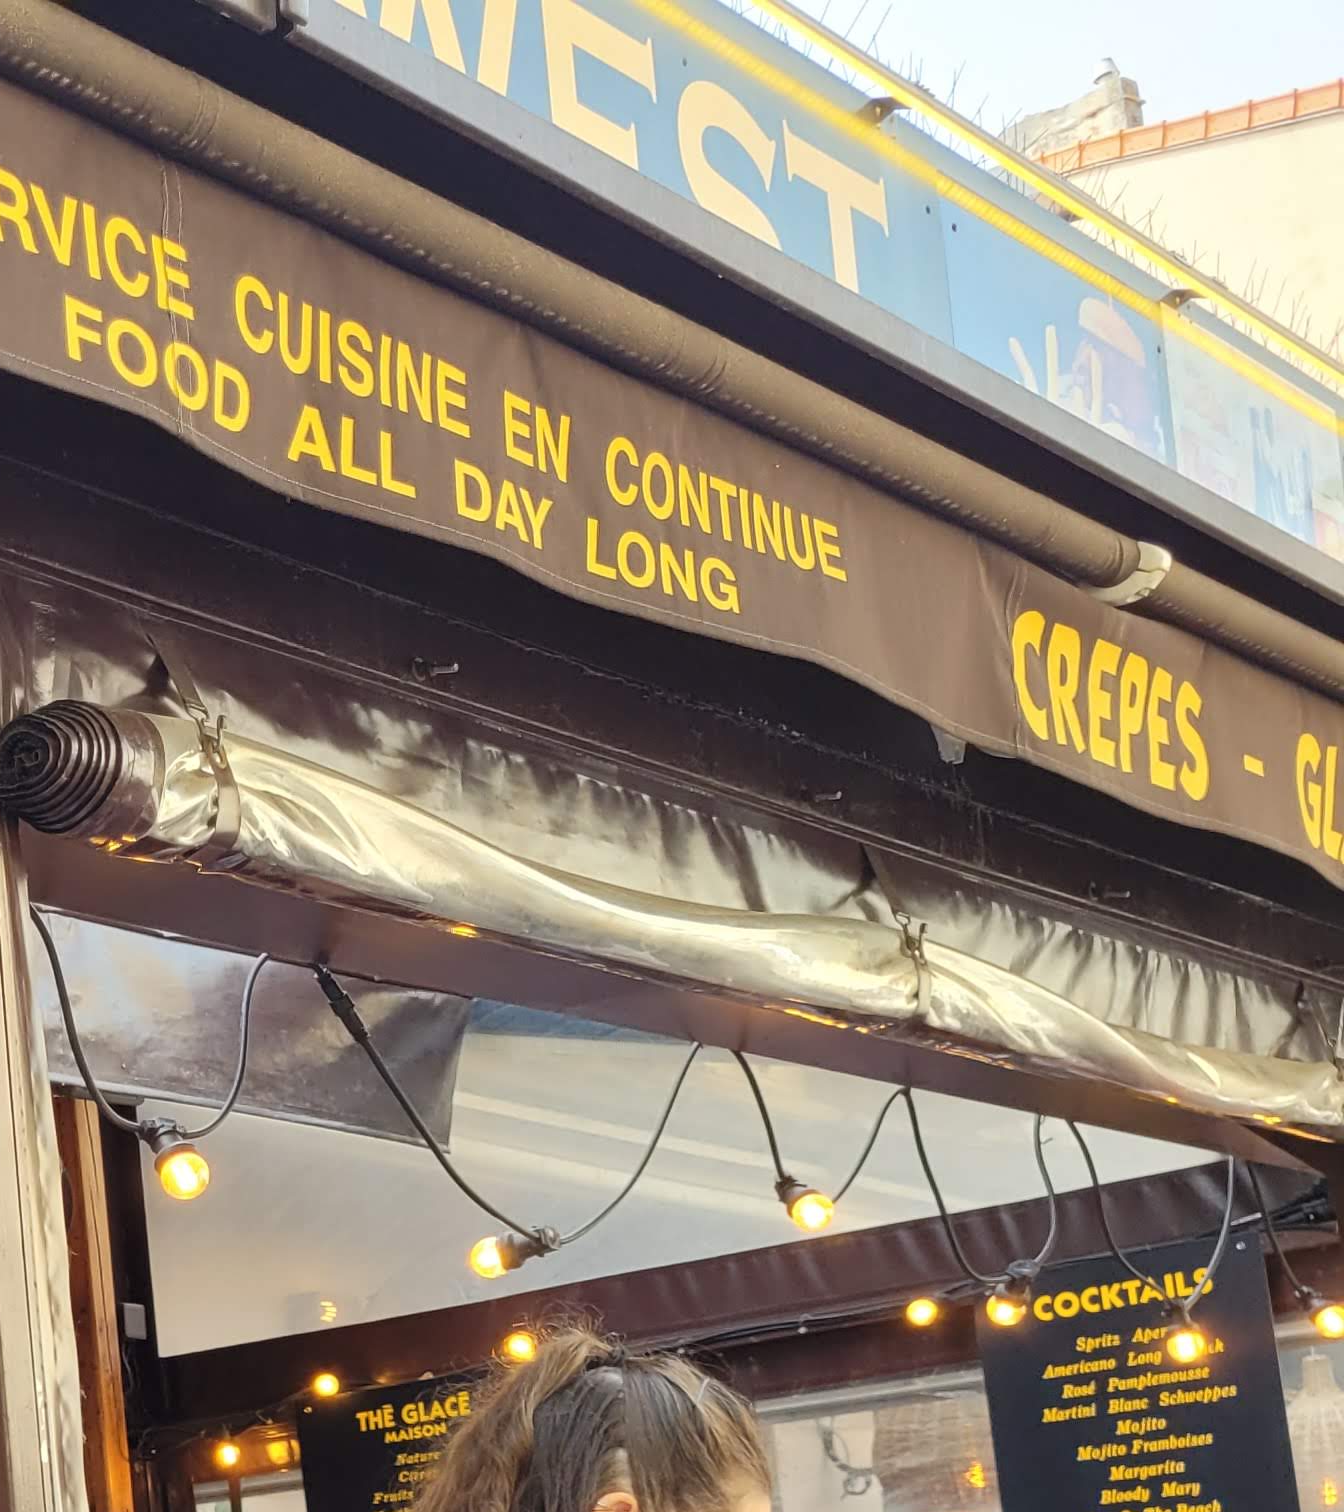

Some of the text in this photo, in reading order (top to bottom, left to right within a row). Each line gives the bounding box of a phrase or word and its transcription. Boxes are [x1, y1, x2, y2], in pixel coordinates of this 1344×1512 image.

[235, 275, 470, 438] CUISINE
[504, 390, 571, 483] EN
[605, 436, 847, 582] CONTINUE
[64, 294, 740, 614] FOOD ALL DAY LONG
[1012, 610, 1210, 801] CREPES
[1296, 733, 1344, 866] GL
[1032, 1267, 1214, 1322] COCKTAILS
[1042, 1350, 1162, 1380] Americano Long
[1062, 1366, 1210, 1399] Rosé Pamplemousse
[1041, 1385, 1237, 1423] Martini Blanc Schweppes
[384, 1422, 448, 1444] MAISON
[1115, 1416, 1167, 1435] Mojito
[1076, 1433, 1213, 1462] Mojito Framboises
[1109, 1460, 1186, 1481] Margarita
[372, 1488, 414, 1505] Fruits
[1099, 1481, 1201, 1505] Bloody Mary
